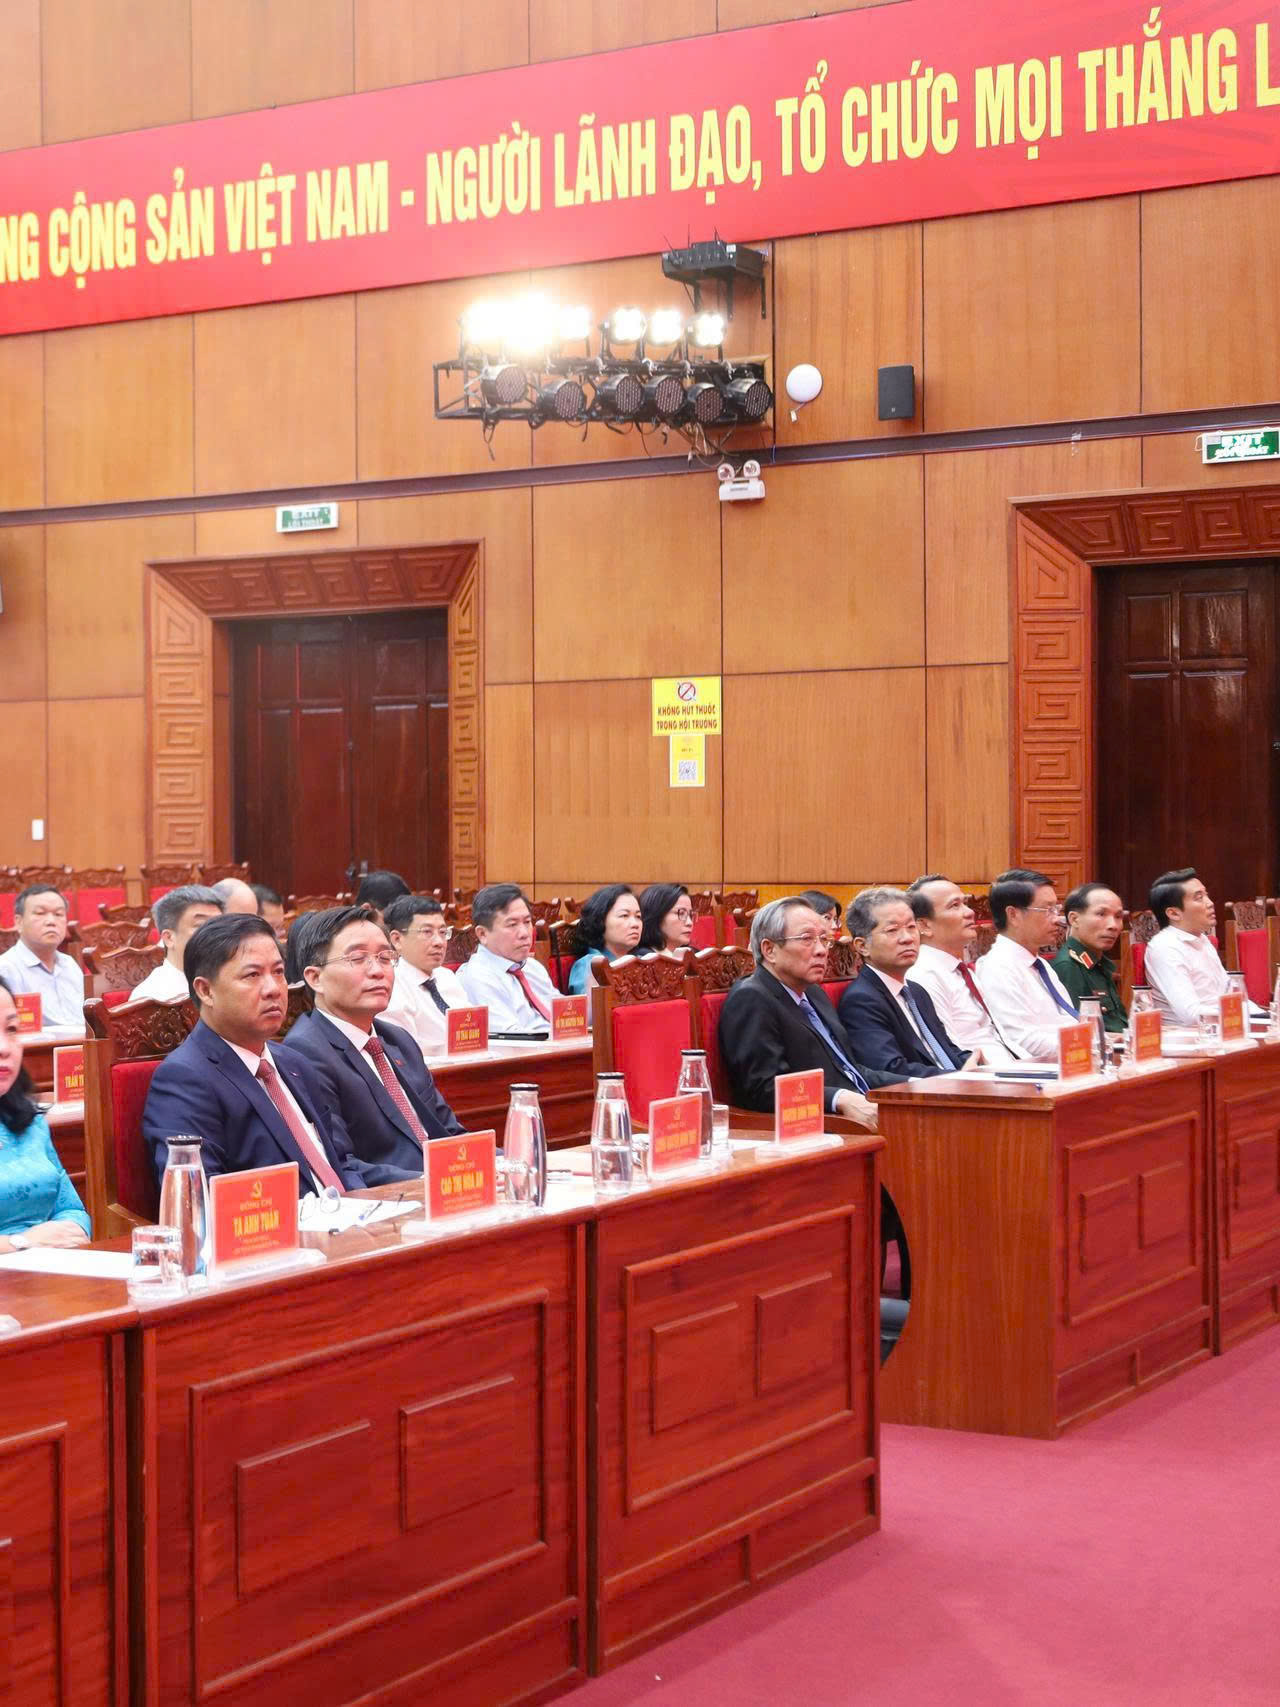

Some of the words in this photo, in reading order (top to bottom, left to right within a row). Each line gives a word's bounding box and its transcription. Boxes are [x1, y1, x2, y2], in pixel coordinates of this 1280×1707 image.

[48, 191, 137, 289] CỘNG
[145, 167, 215, 265] SẢN
[223, 162, 297, 265] VIỆT
[306, 159, 389, 242] NAM
[426, 120, 541, 225] NGƯỜI
[554, 112, 656, 208] LÃNH
[668, 104, 762, 205] ĐẠO,
[775, 59, 828, 177] TỔ
[841, 60, 958, 167] CHỨC
[975, 55, 1062, 160] MỌI
[1078, 6, 1238, 132] THẮNG
[658, 704, 680, 716] KHÔNG
[657, 720, 677, 730] TRONG
